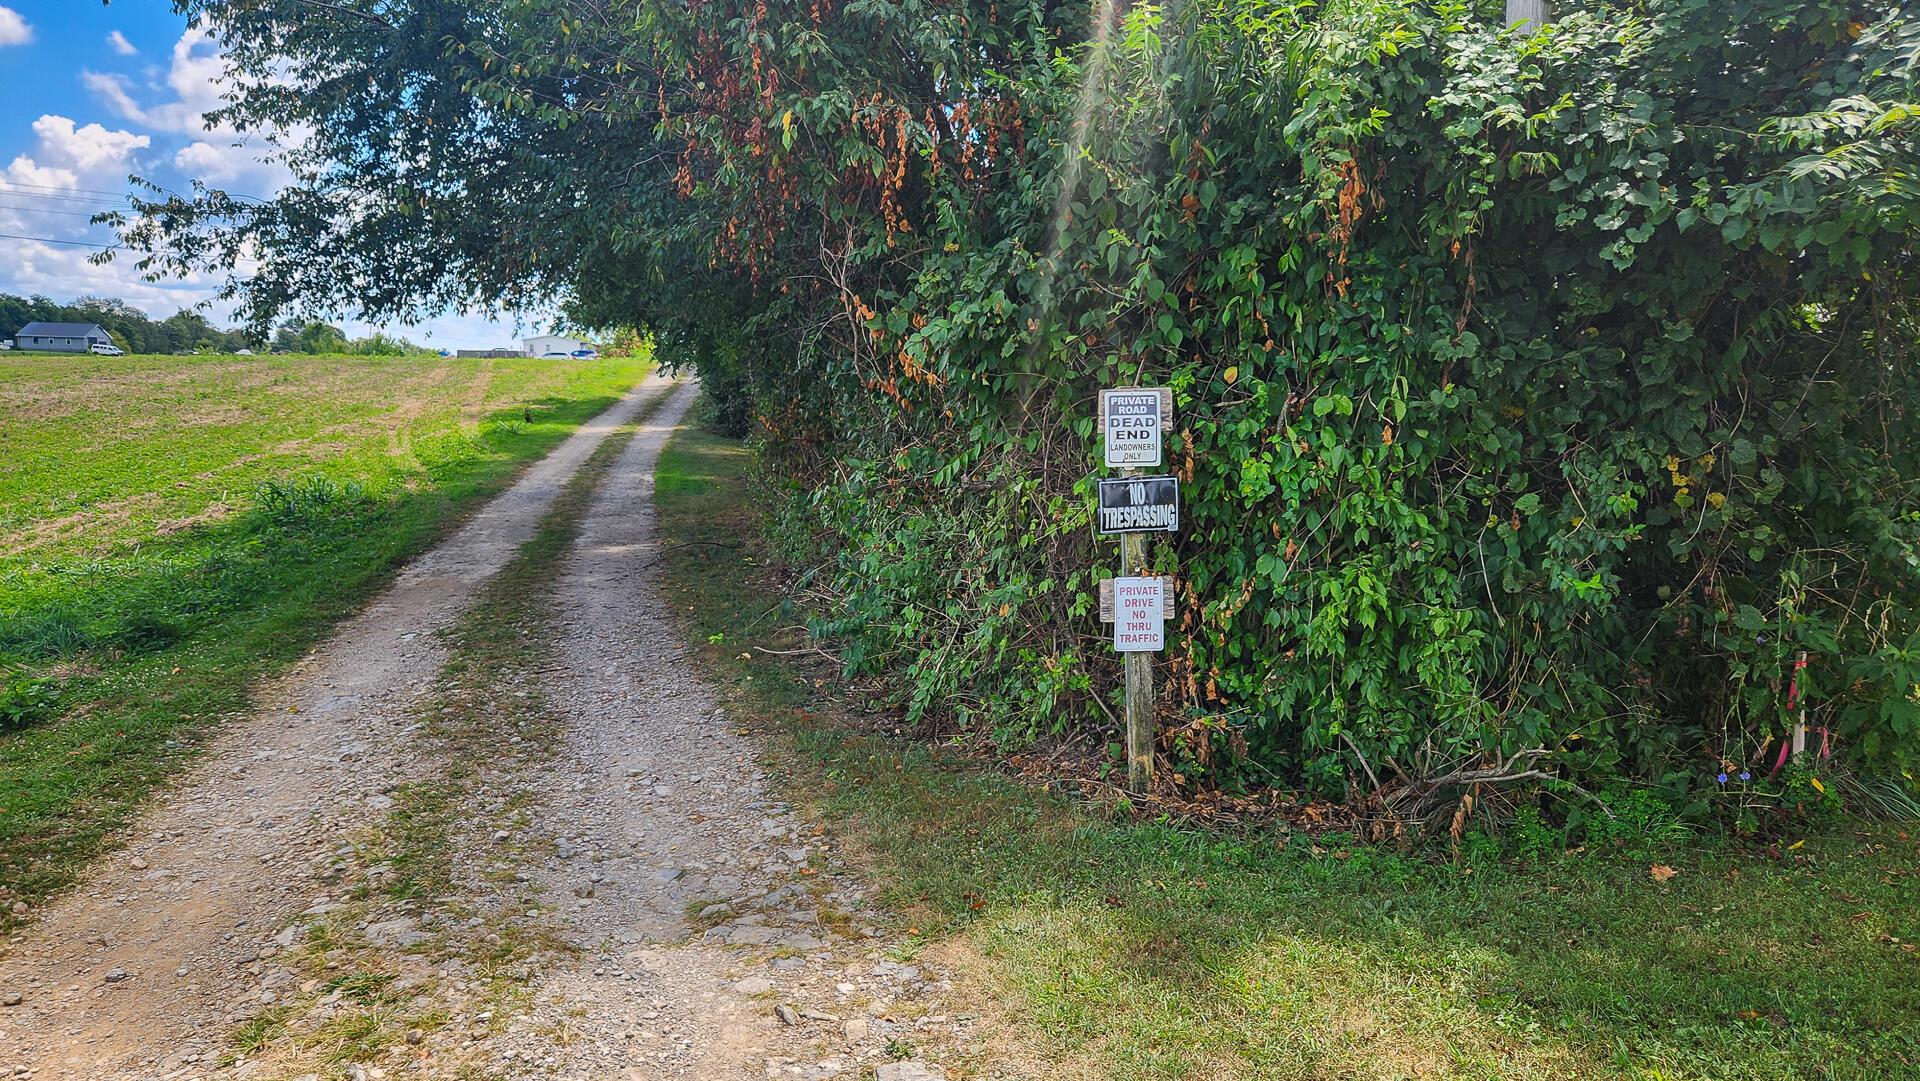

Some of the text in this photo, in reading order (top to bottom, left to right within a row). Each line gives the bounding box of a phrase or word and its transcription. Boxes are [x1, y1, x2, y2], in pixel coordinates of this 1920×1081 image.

[1110, 397, 1155, 405] PRIVATE
[1118, 406, 1147, 414] ROAD
[1111, 418, 1155, 427] DEAD
[1116, 431, 1150, 440] END
[1110, 443, 1156, 451] LANDOWNERS
[1129, 483, 1146, 505] NO
[1104, 504, 1176, 529] TRESPASSING
[1120, 586, 1158, 595] PRIVATE
[1125, 598, 1154, 607] DRIVE
[1132, 610, 1146, 619] NO
[1126, 622, 1151, 630] THRU
[1120, 634, 1158, 642] TRAFFIC
